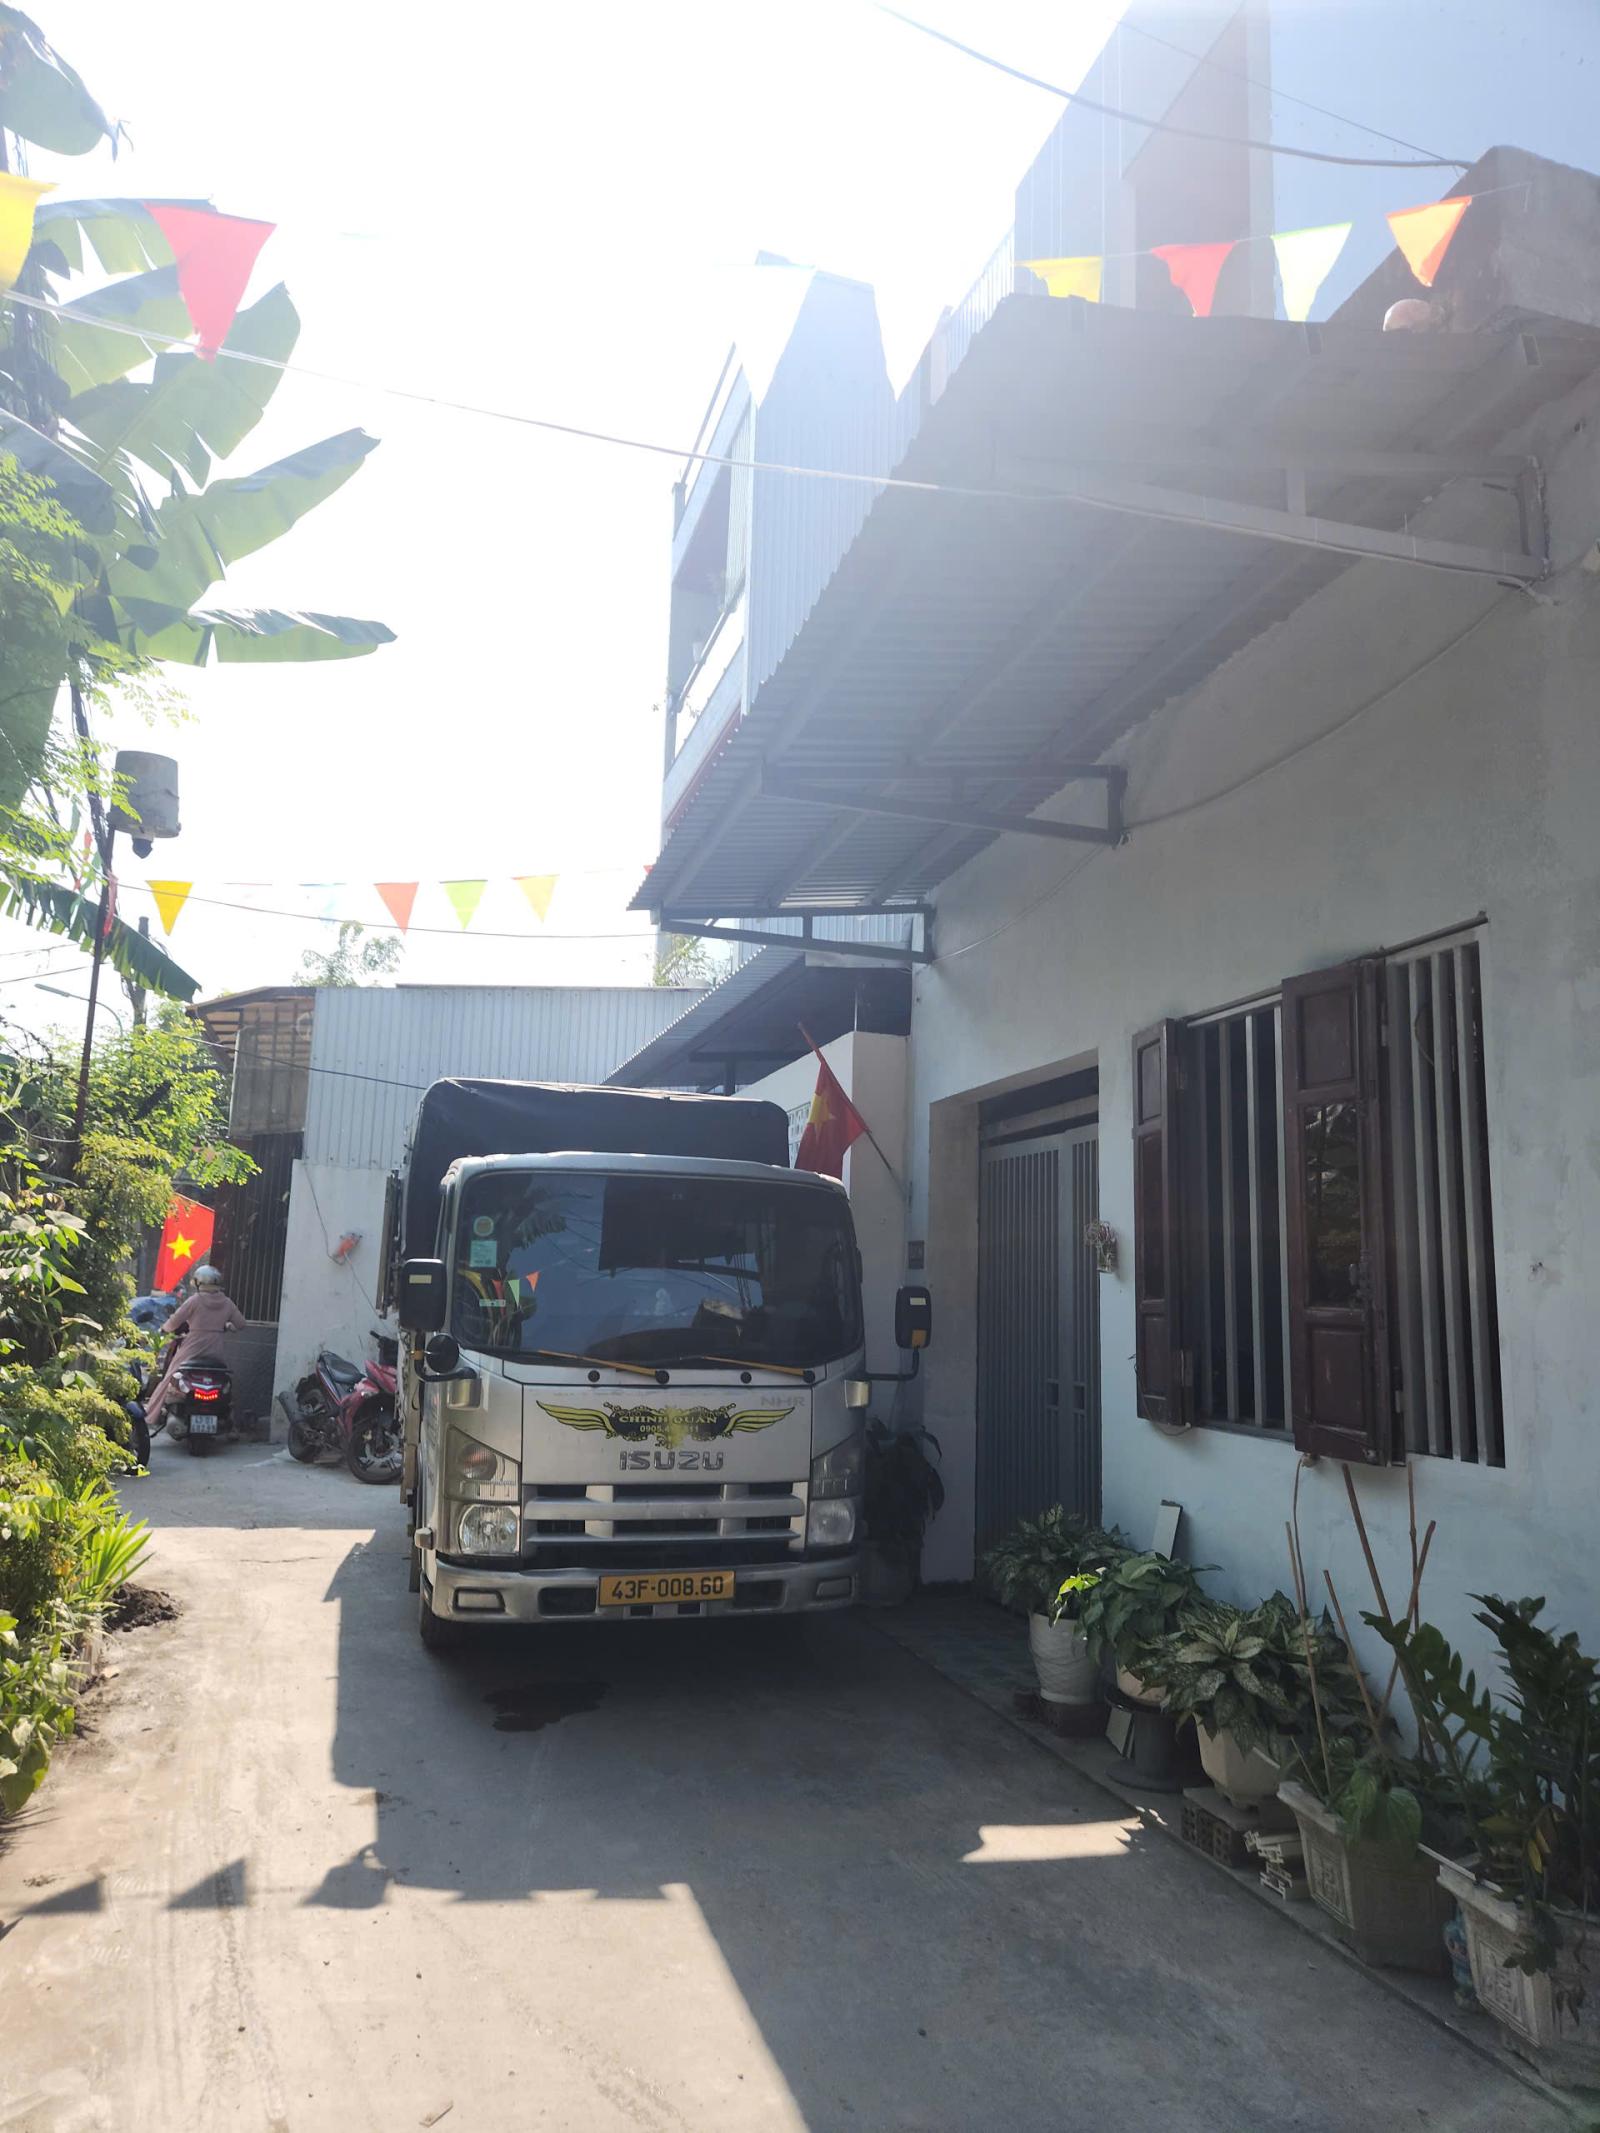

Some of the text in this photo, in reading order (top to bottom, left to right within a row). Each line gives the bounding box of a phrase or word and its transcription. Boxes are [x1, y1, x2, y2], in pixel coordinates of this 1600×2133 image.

[760, 1396, 806, 1407] NHR
[619, 1451, 724, 1470] ISUZU
[611, 1576, 724, 1600] 43F-008.60
